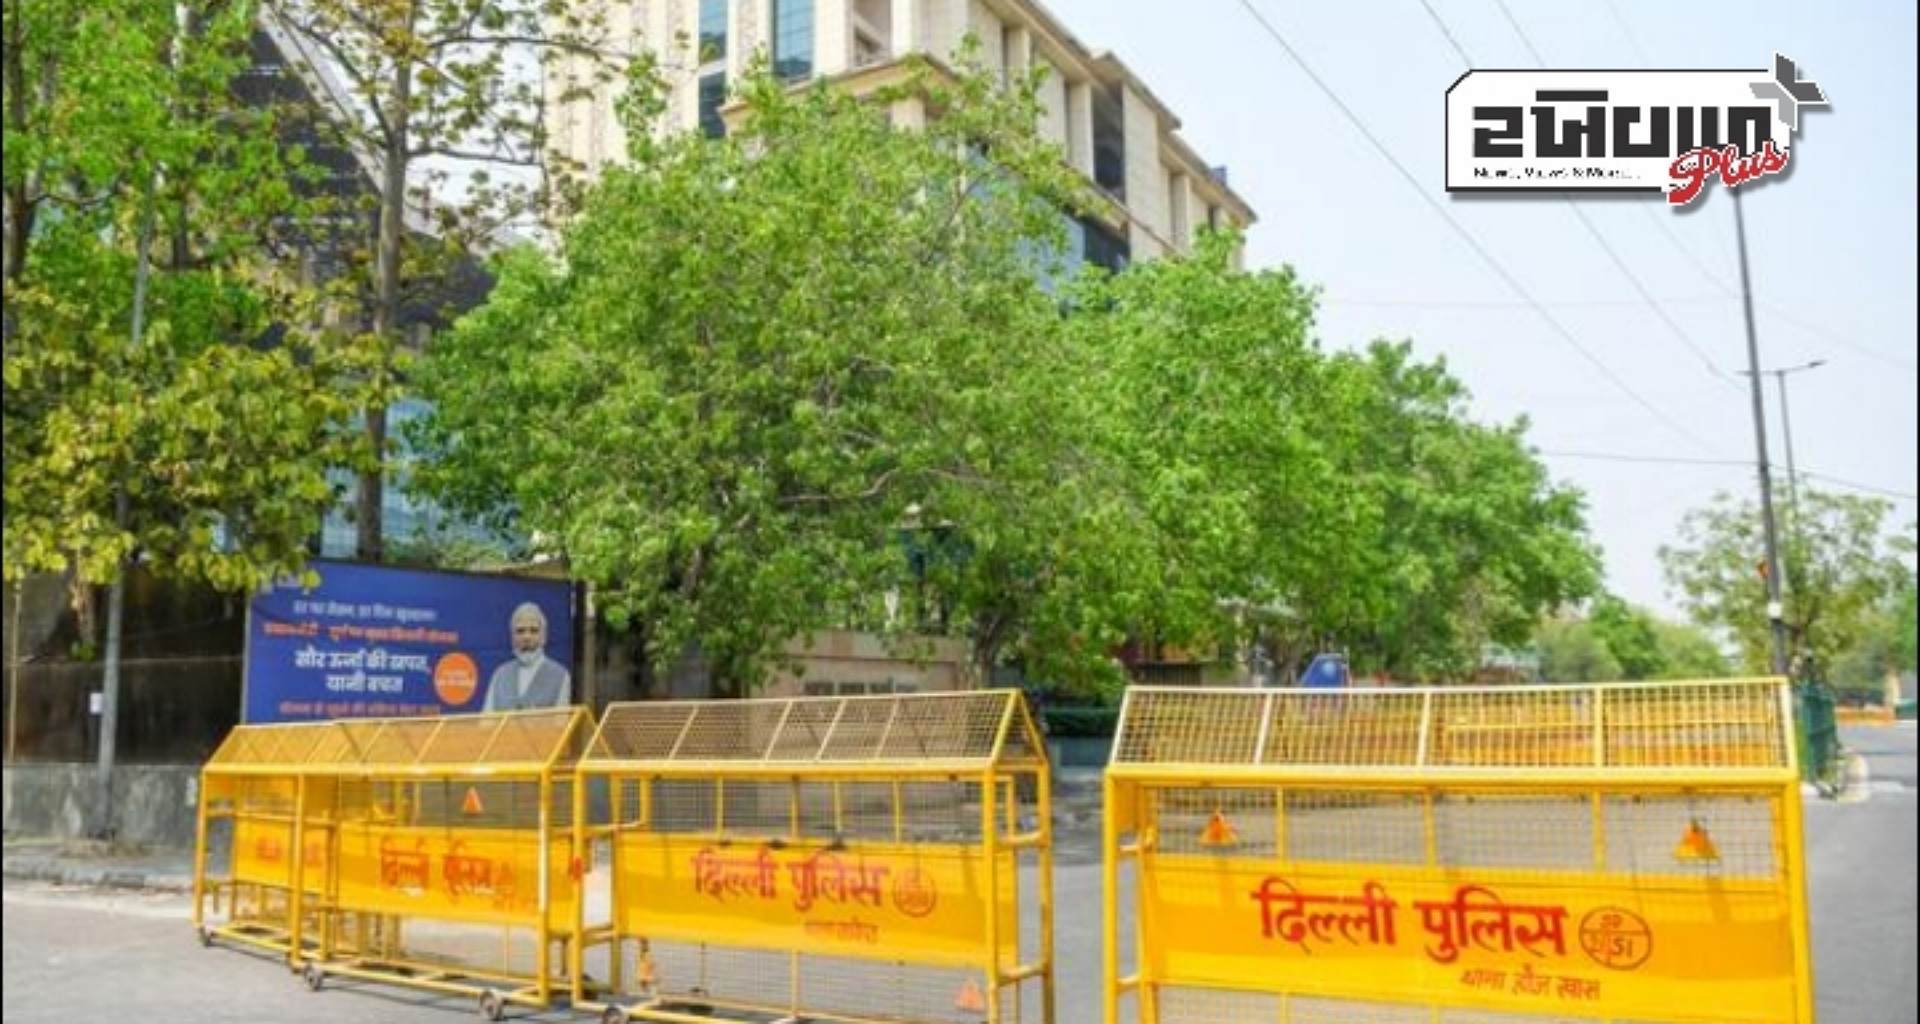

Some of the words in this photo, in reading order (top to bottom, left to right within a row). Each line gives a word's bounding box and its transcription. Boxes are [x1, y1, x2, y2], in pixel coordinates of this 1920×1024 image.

[690, 848, 778, 903] दिल्ली
[786, 849, 890, 913] पुलिस
[1250, 876, 1397, 955] दिल्ली
[1412, 884, 1570, 964] पुलिस
